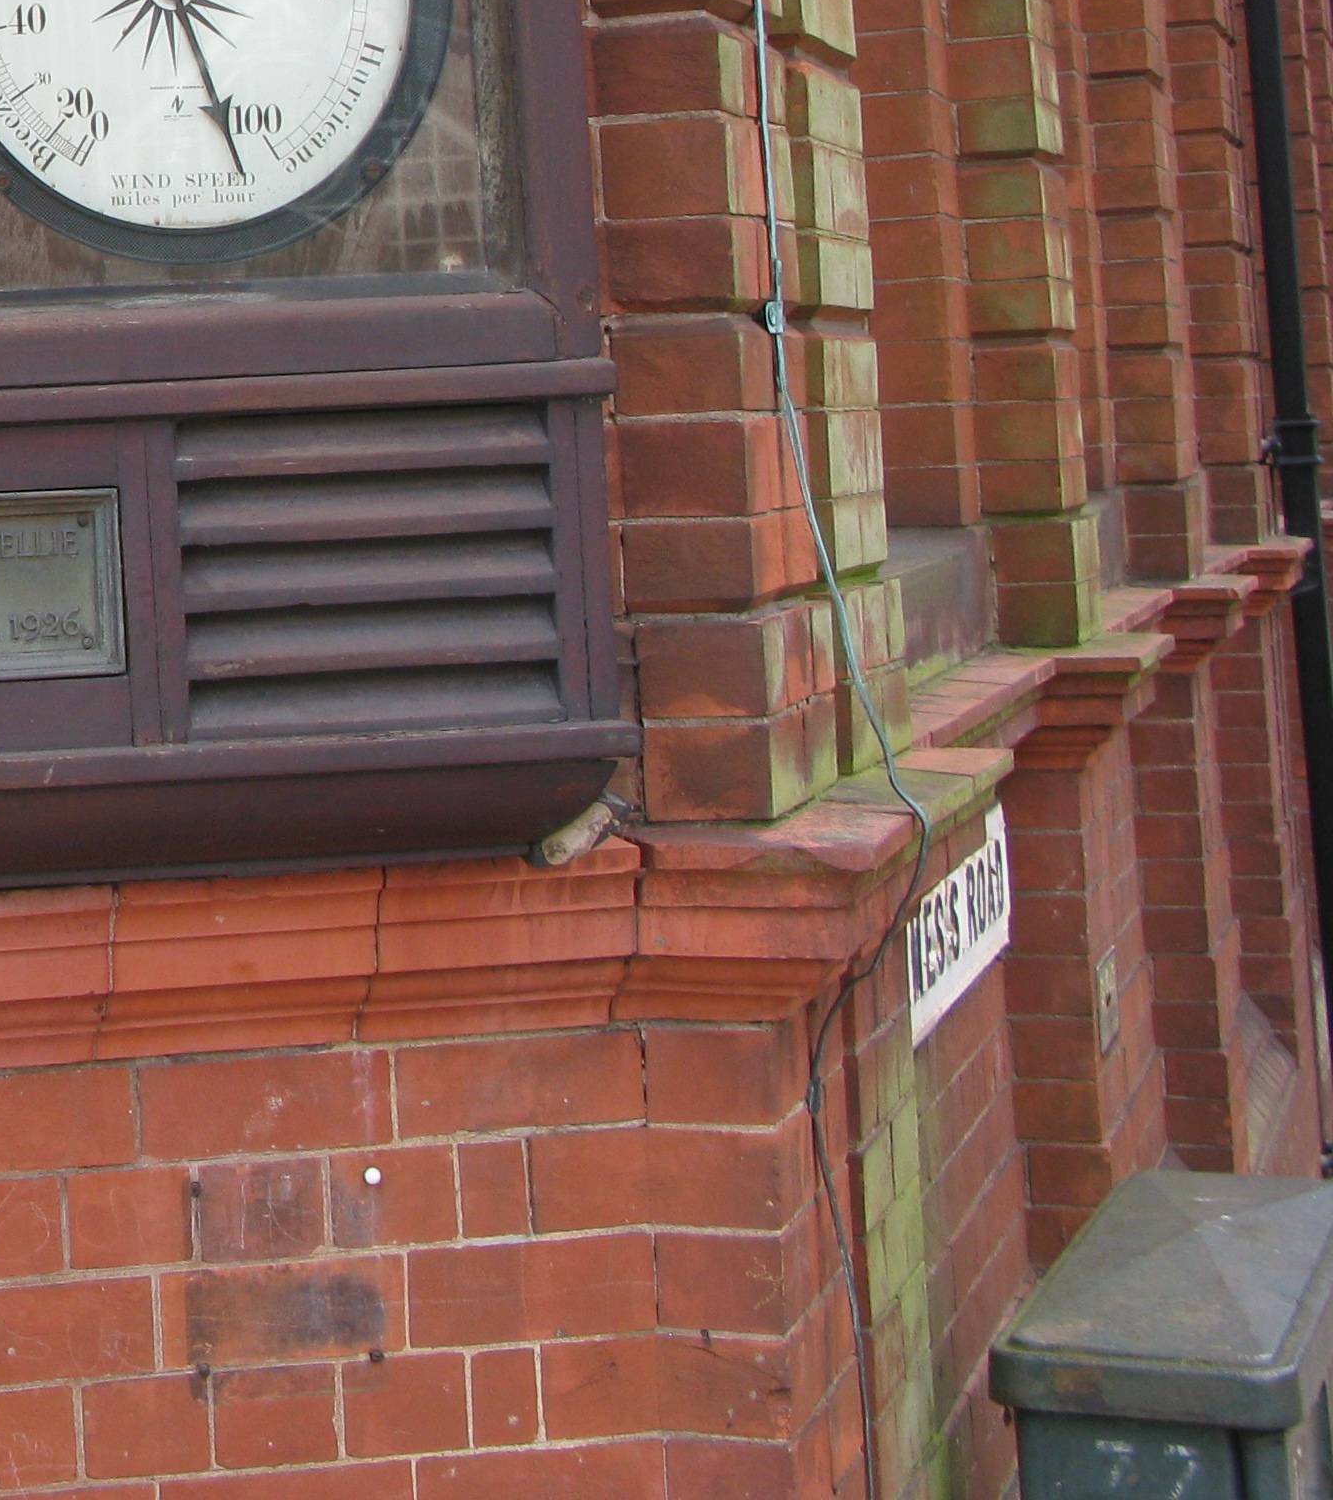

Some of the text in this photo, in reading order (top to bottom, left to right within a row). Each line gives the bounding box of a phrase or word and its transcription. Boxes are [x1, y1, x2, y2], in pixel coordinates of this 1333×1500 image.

[8, 3, 46, 35] 40
[33, 71, 51, 86] 30
[57, 87, 93, 119] 20
[285, 41, 386, 175] Hurricane
[90, 110, 109, 142] 0
[232, 104, 282, 136] 100
[111, 172, 255, 189] WIND SPEED
[111, 189, 255, 208] miles per hour
[965, 839, 1004, 947] ROAD
